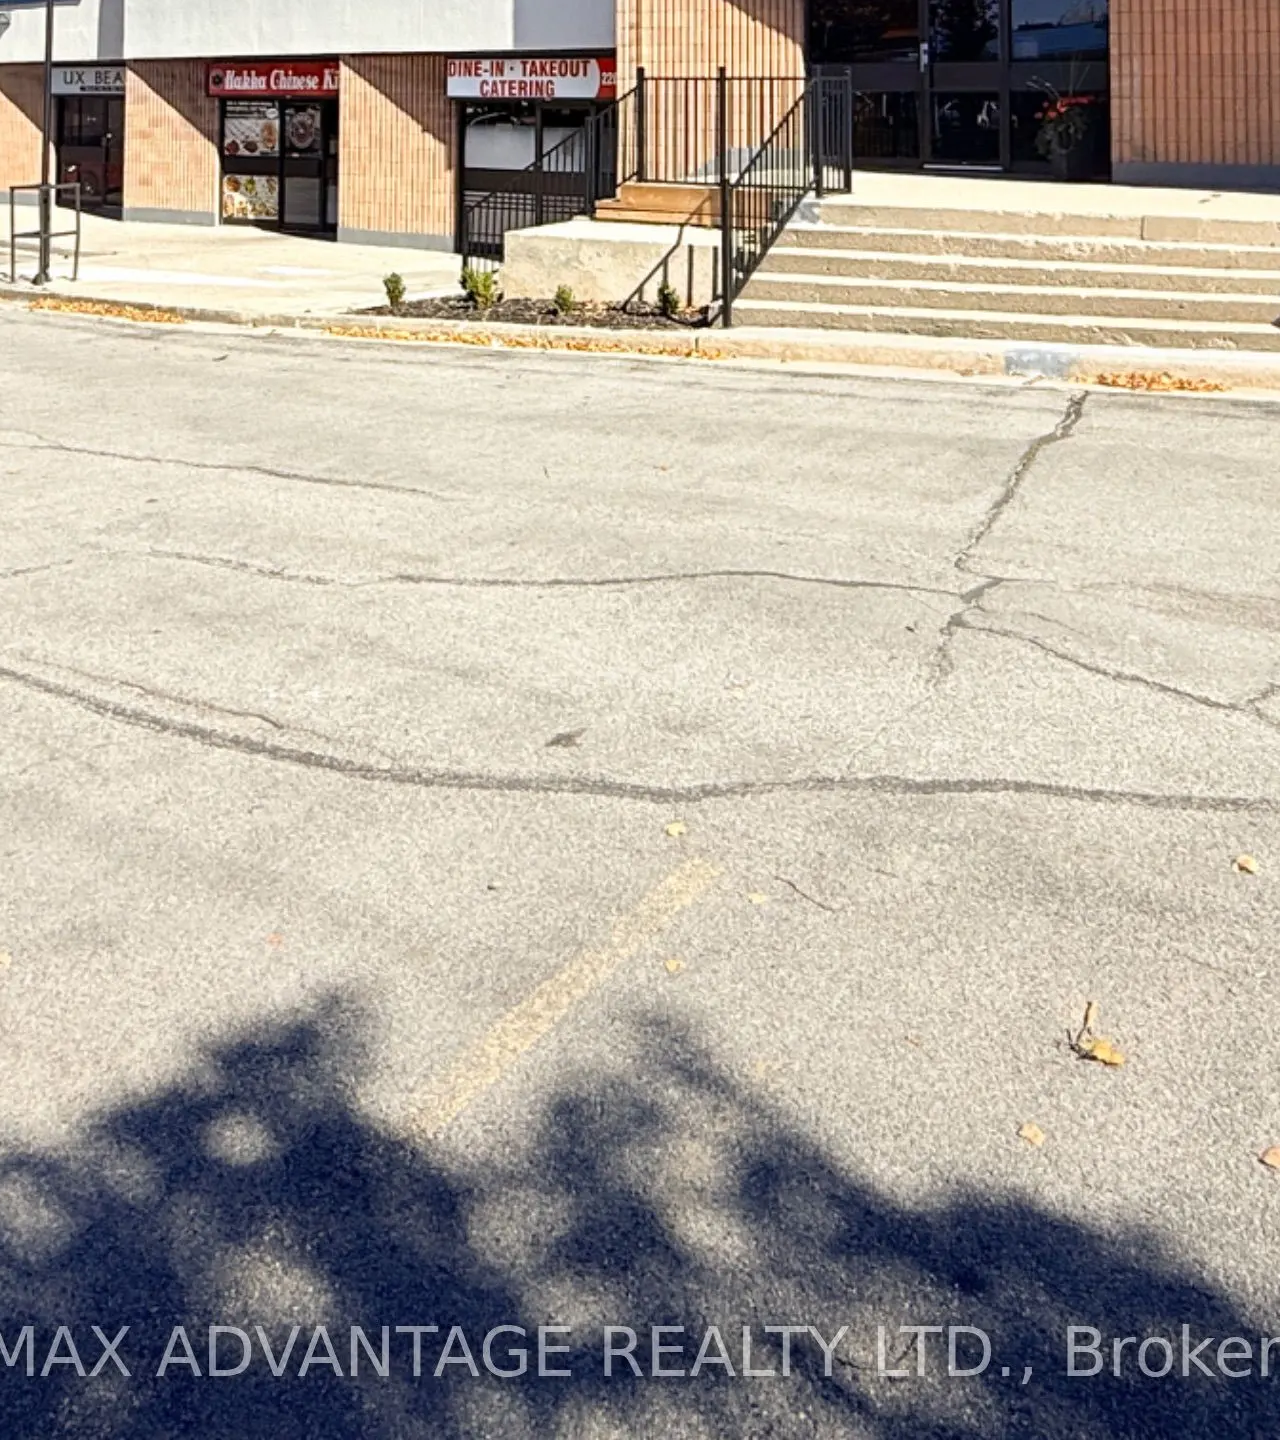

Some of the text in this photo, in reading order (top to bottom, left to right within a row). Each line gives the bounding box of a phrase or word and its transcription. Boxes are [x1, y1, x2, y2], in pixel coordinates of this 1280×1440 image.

[448, 61, 591, 78] DINE-IN TAKEOUT
[224, 69, 268, 91] Hakka
[270, 69, 320, 91] Chinese
[480, 80, 555, 98] CATERING
